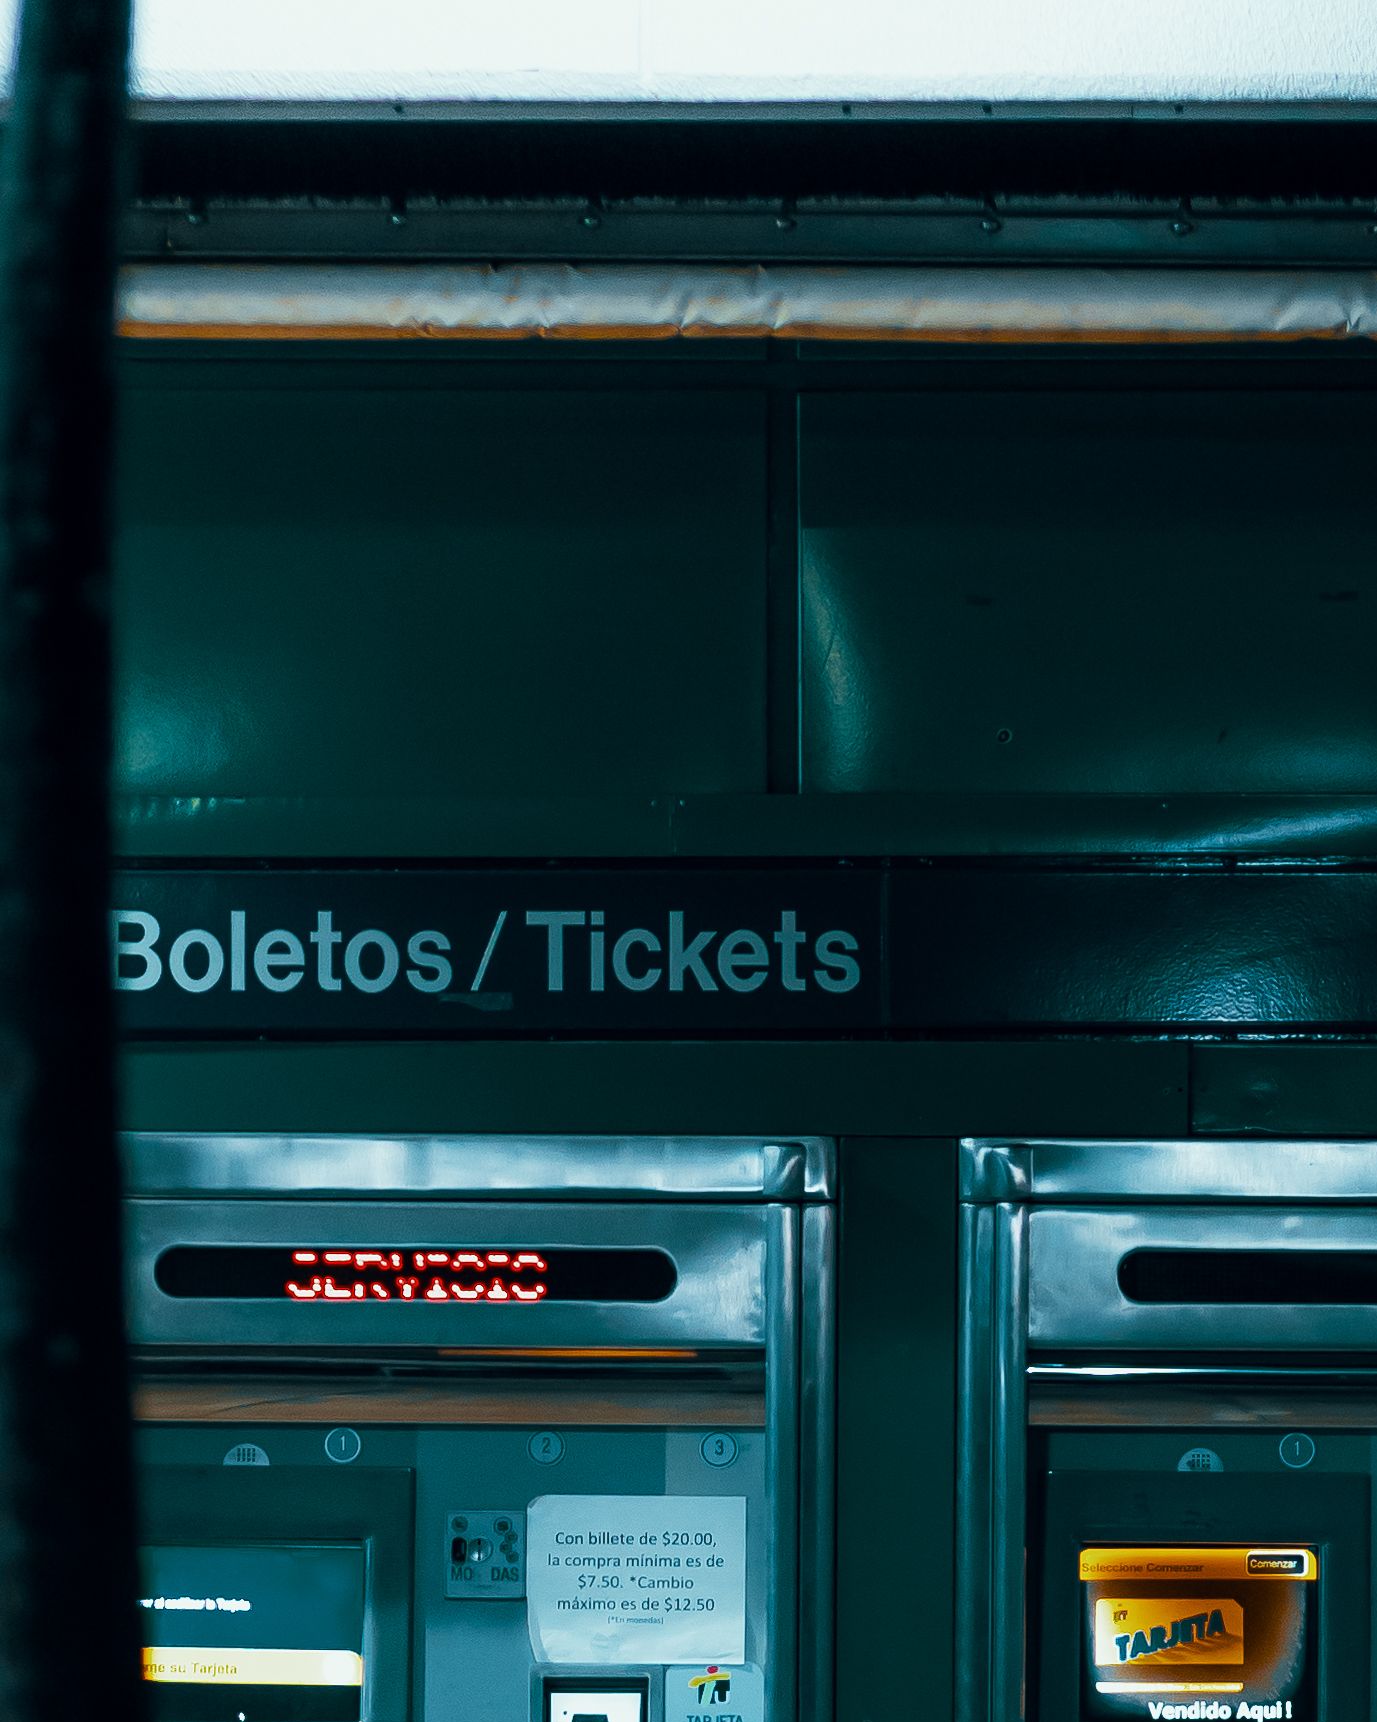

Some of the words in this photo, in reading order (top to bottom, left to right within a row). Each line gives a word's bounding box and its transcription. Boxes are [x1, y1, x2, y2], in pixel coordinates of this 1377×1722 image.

[113, 911, 452, 993] Boletos
[470, 911, 508, 992] /
[526, 911, 860, 993] Tickets
[555, 1532, 583, 1545] Con
[589, 1531, 635, 1546] billete
[639, 1532, 657, 1546] de
[662, 1531, 717, 1548] $20.00,
[548, 1554, 560, 1567] la
[565, 1557, 621, 1570] compra
[626, 1554, 680, 1568] mínima
[686, 1557, 701, 1568] es
[706, 1554, 724, 1568] de
[451, 1566, 519, 1582] MODAS
[578, 1574, 624, 1590] $7.50.
[557, 1597, 616, 1611] máximo
[621, 1601, 636, 1611] es
[641, 1597, 660, 1611] de
[664, 1597, 715, 1613] $12.50
[191, 1662, 237, 1676] Tarjeta
[1148, 1701, 1232, 1720] Vendido
